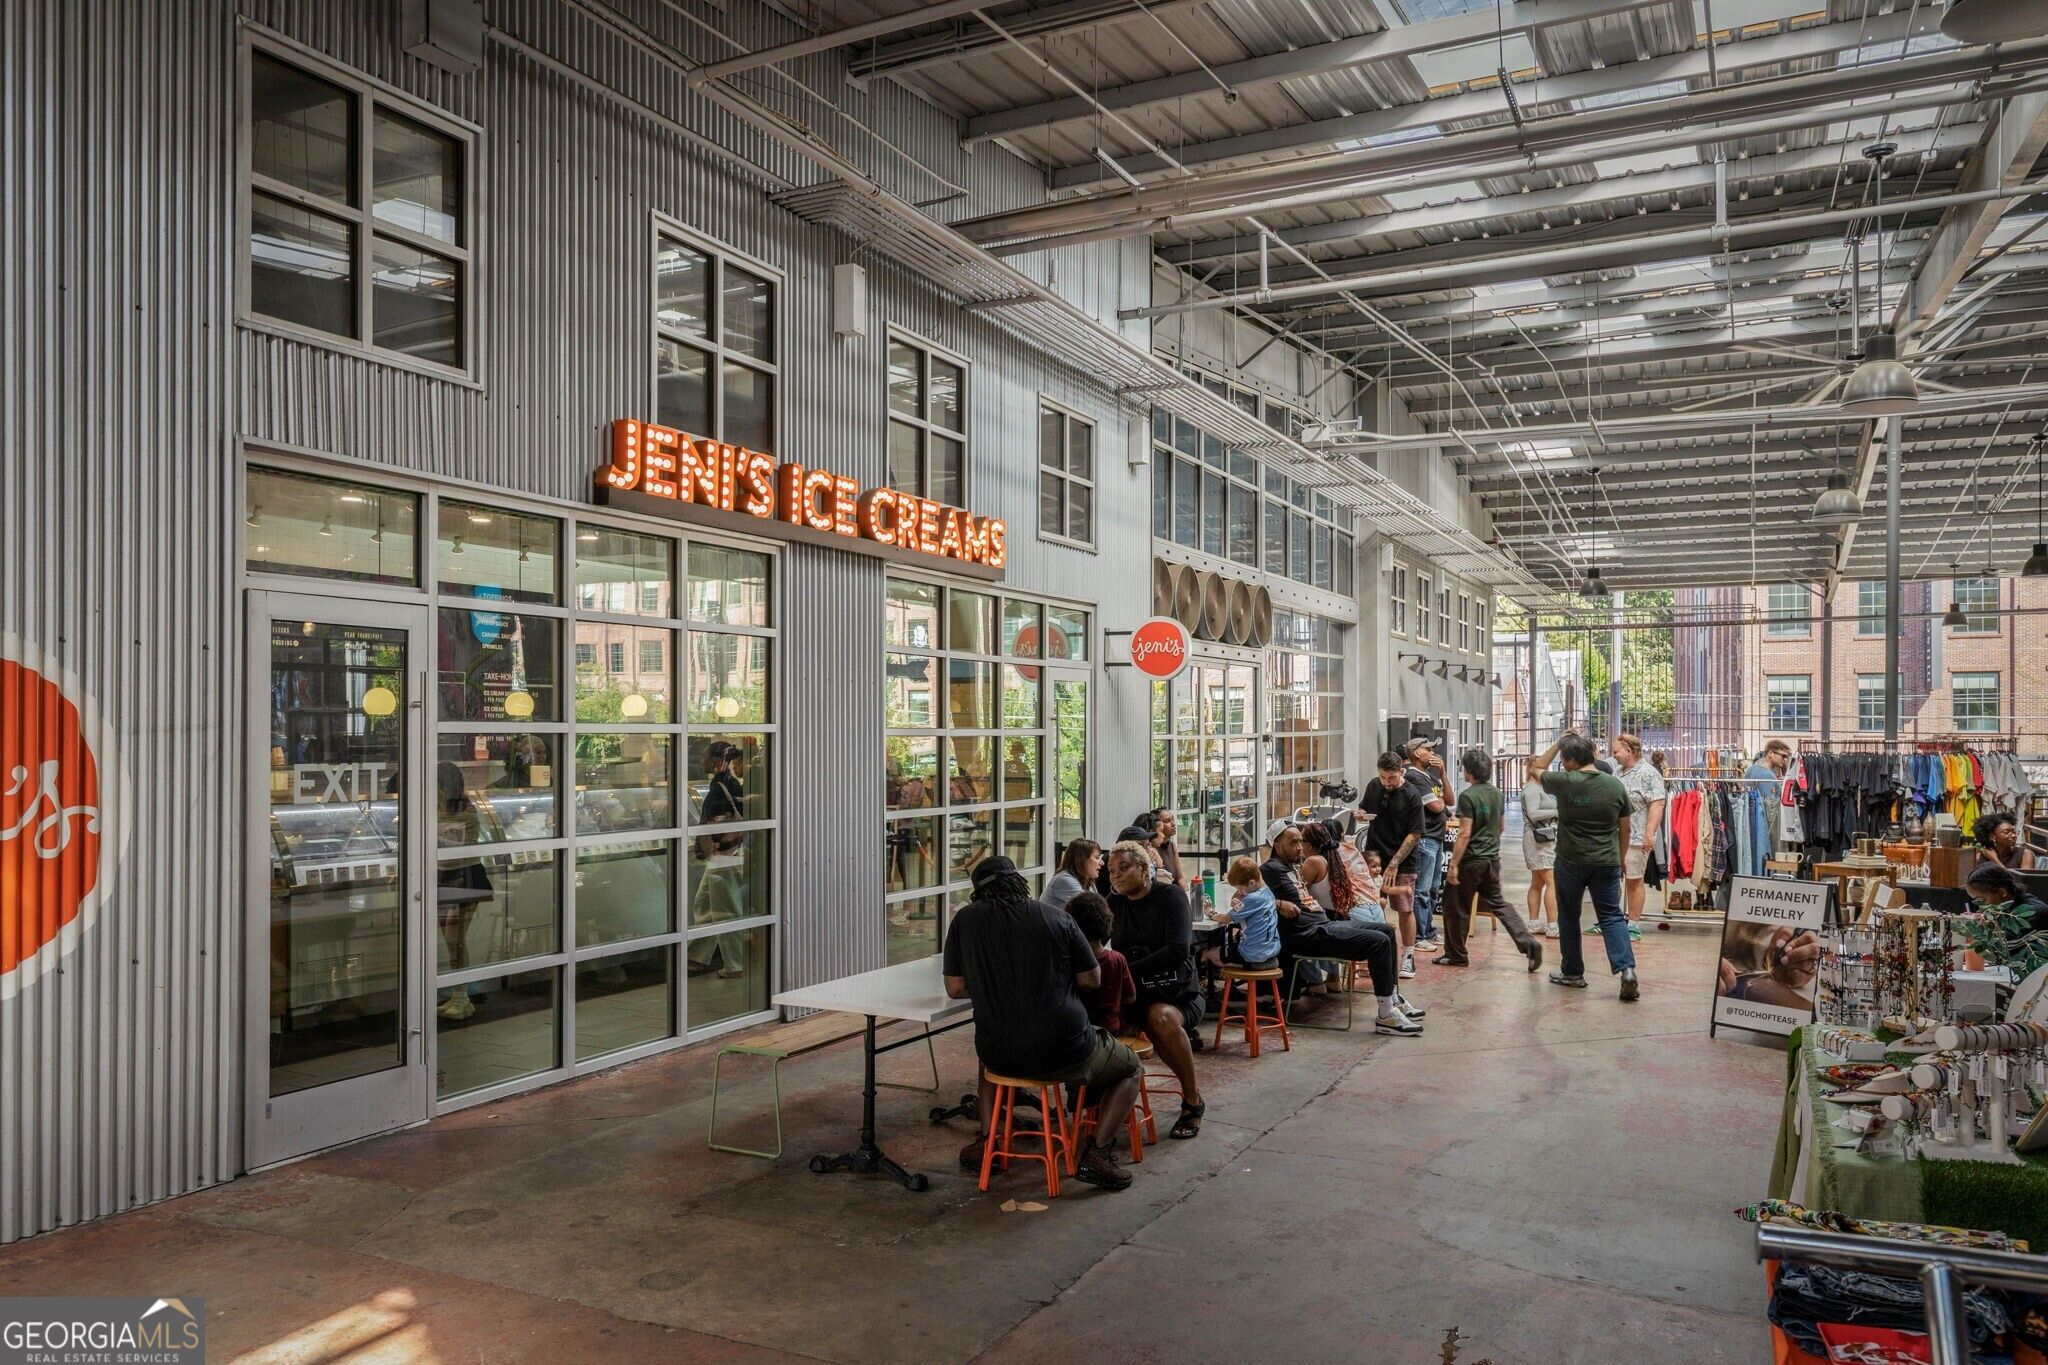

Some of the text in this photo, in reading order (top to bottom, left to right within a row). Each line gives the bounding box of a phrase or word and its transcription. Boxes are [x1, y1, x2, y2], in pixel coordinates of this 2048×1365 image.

[596, 418, 1007, 569] JENI'S ICE CREAMS
[1132, 637, 1184, 661] jeni's
[483, 672, 514, 681] TAKE-HOM
[293, 762, 387, 804] EXIT
[1740, 887, 1820, 905] PERMANENT
[1746, 905, 1805, 921] JEWELRY
[1726, 1006, 1798, 1026] @TOUCHOFTEASE
